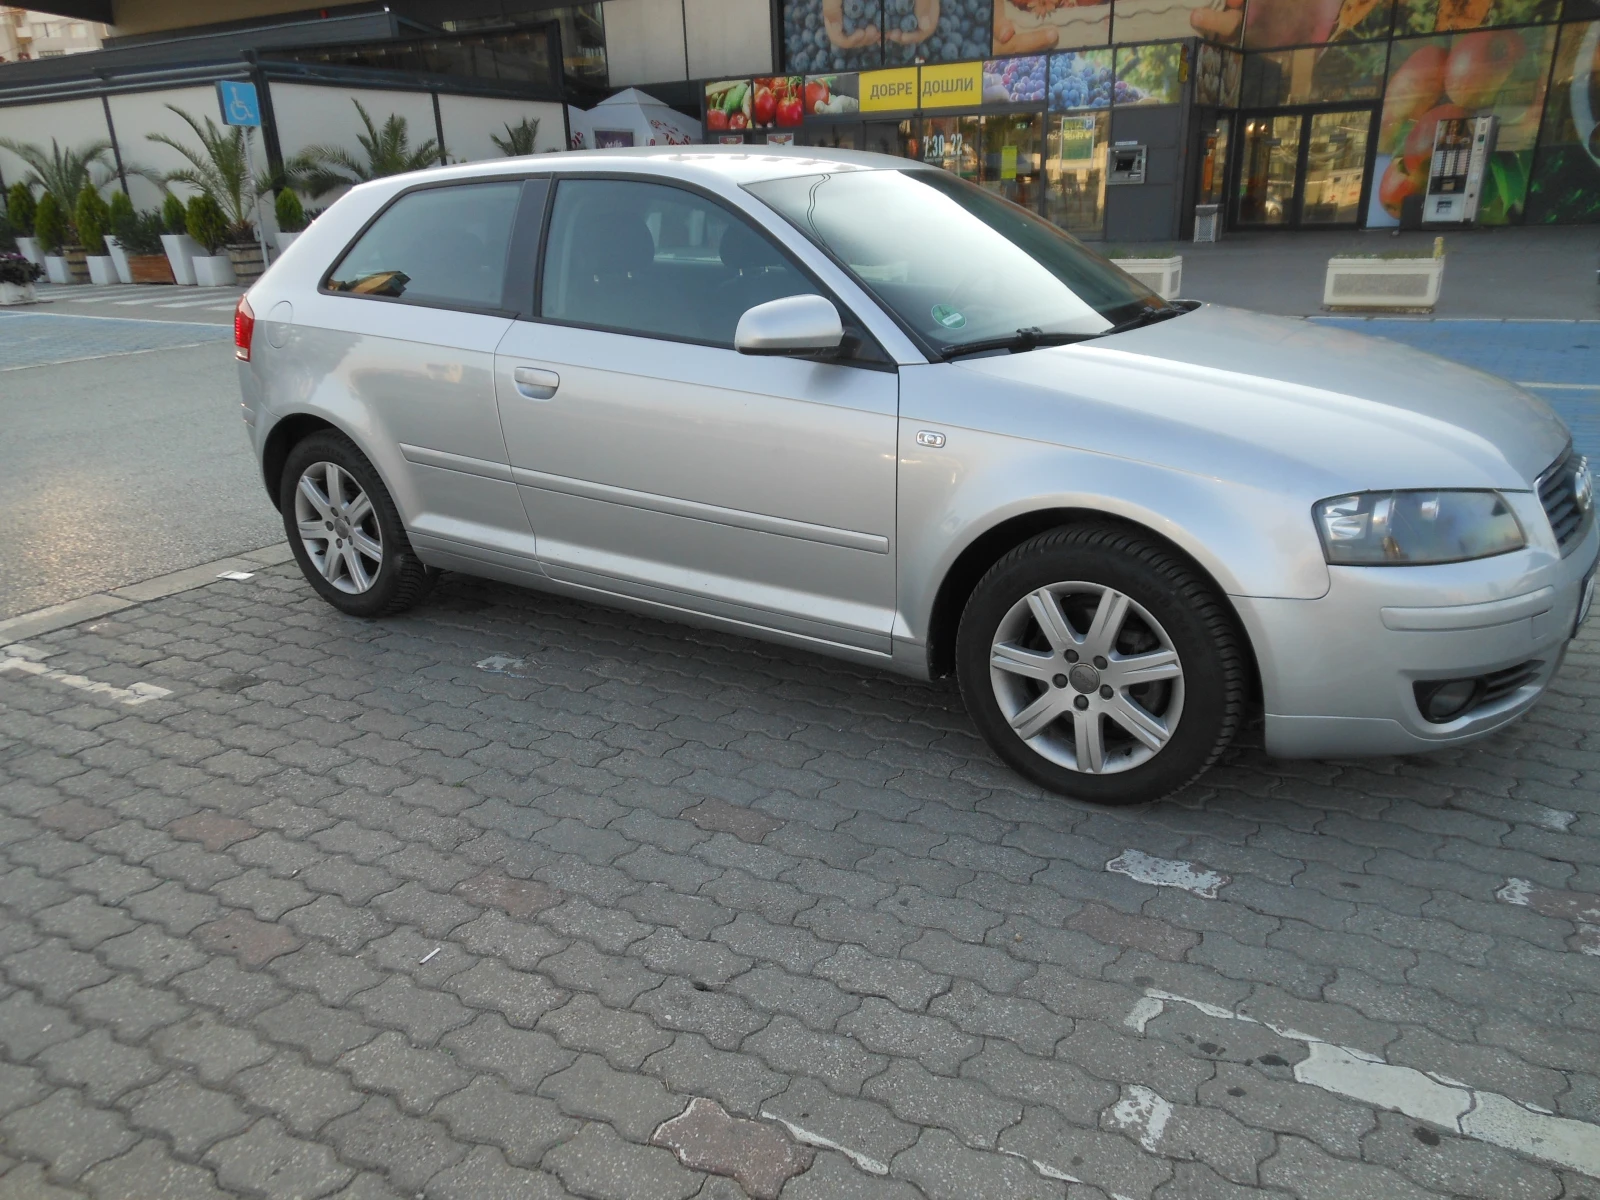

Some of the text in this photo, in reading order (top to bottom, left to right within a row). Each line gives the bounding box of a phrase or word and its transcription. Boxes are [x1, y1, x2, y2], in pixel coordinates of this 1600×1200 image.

[869, 77, 974, 100] ДОБРЕ ДОШЛИ
[923, 134, 945, 157] 7:30
[951, 133, 963, 155] 22
